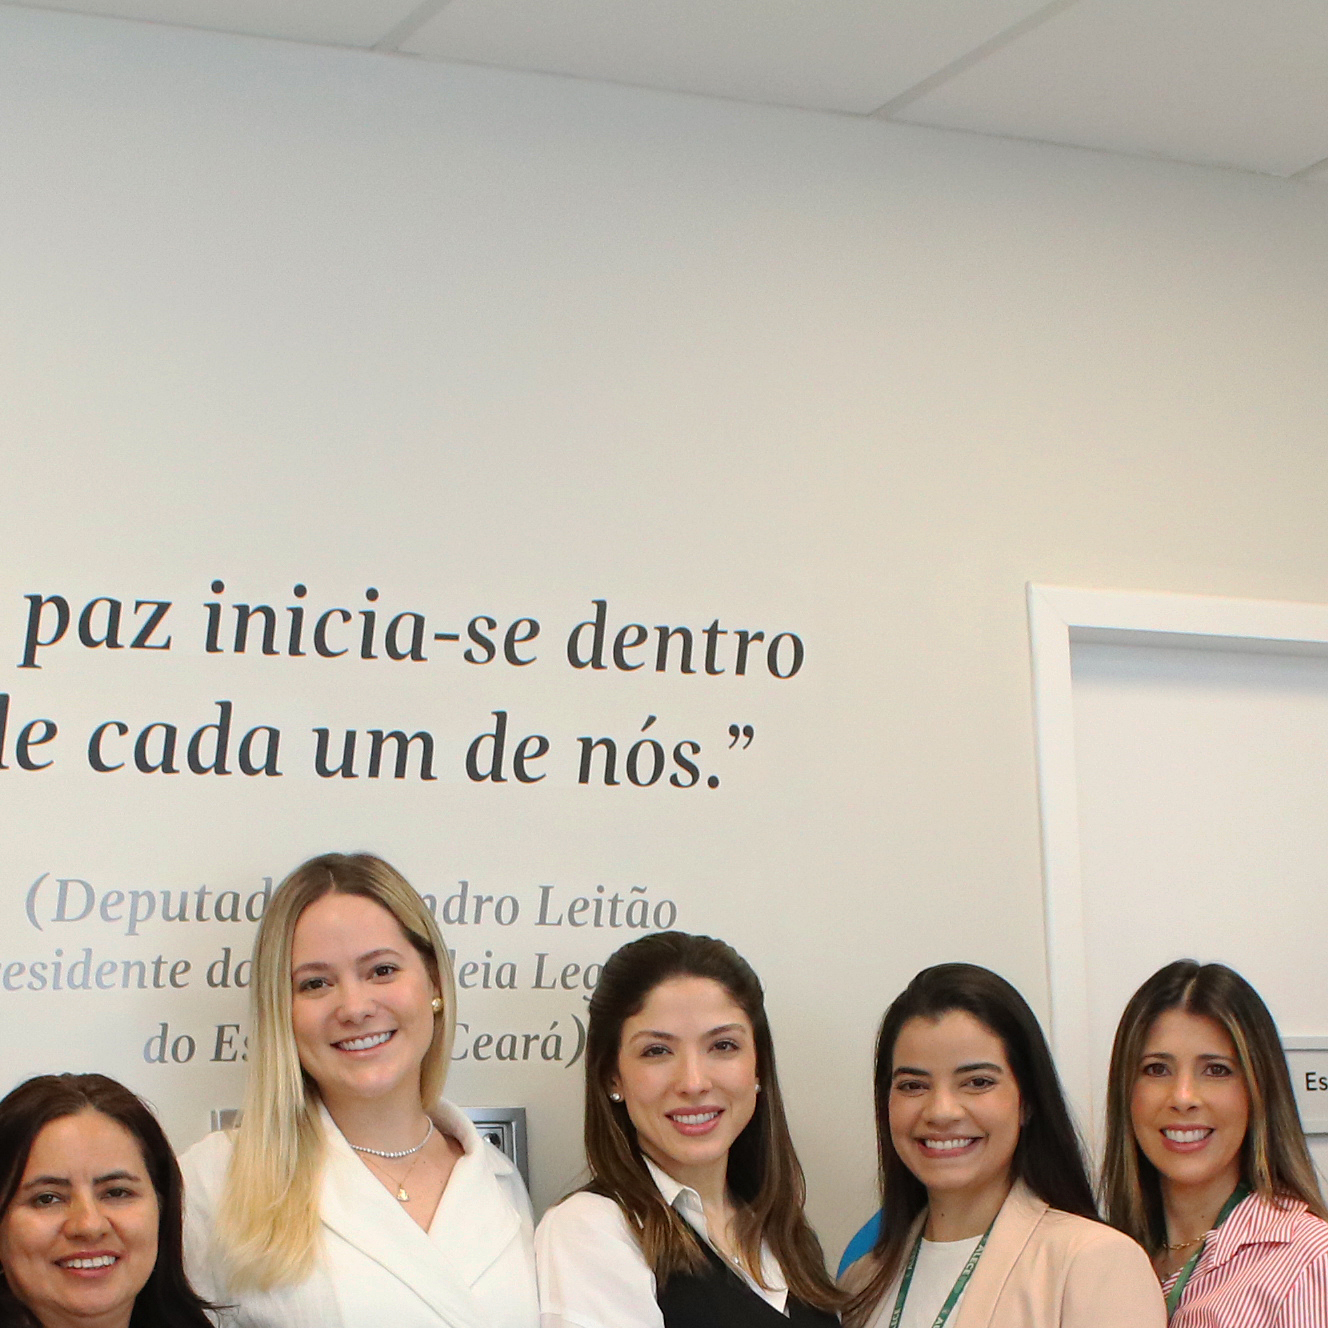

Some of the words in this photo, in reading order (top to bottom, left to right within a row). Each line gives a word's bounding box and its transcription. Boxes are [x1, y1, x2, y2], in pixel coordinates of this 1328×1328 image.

[17, 594, 173, 669] paz
[203, 579, 541, 667] inicia-se
[566, 599, 804, 680] dentro
[87, 700, 283, 777] cada
[311, 726, 438, 781] um
[465, 710, 550, 784] de
[576, 714, 755, 789] nós.”
[25, 872, 272, 936] (Deputad
[534, 885, 677, 929] Leitão
[143, 1022, 196, 1064] do
[963, 1244, 985, 1275] ALECE
